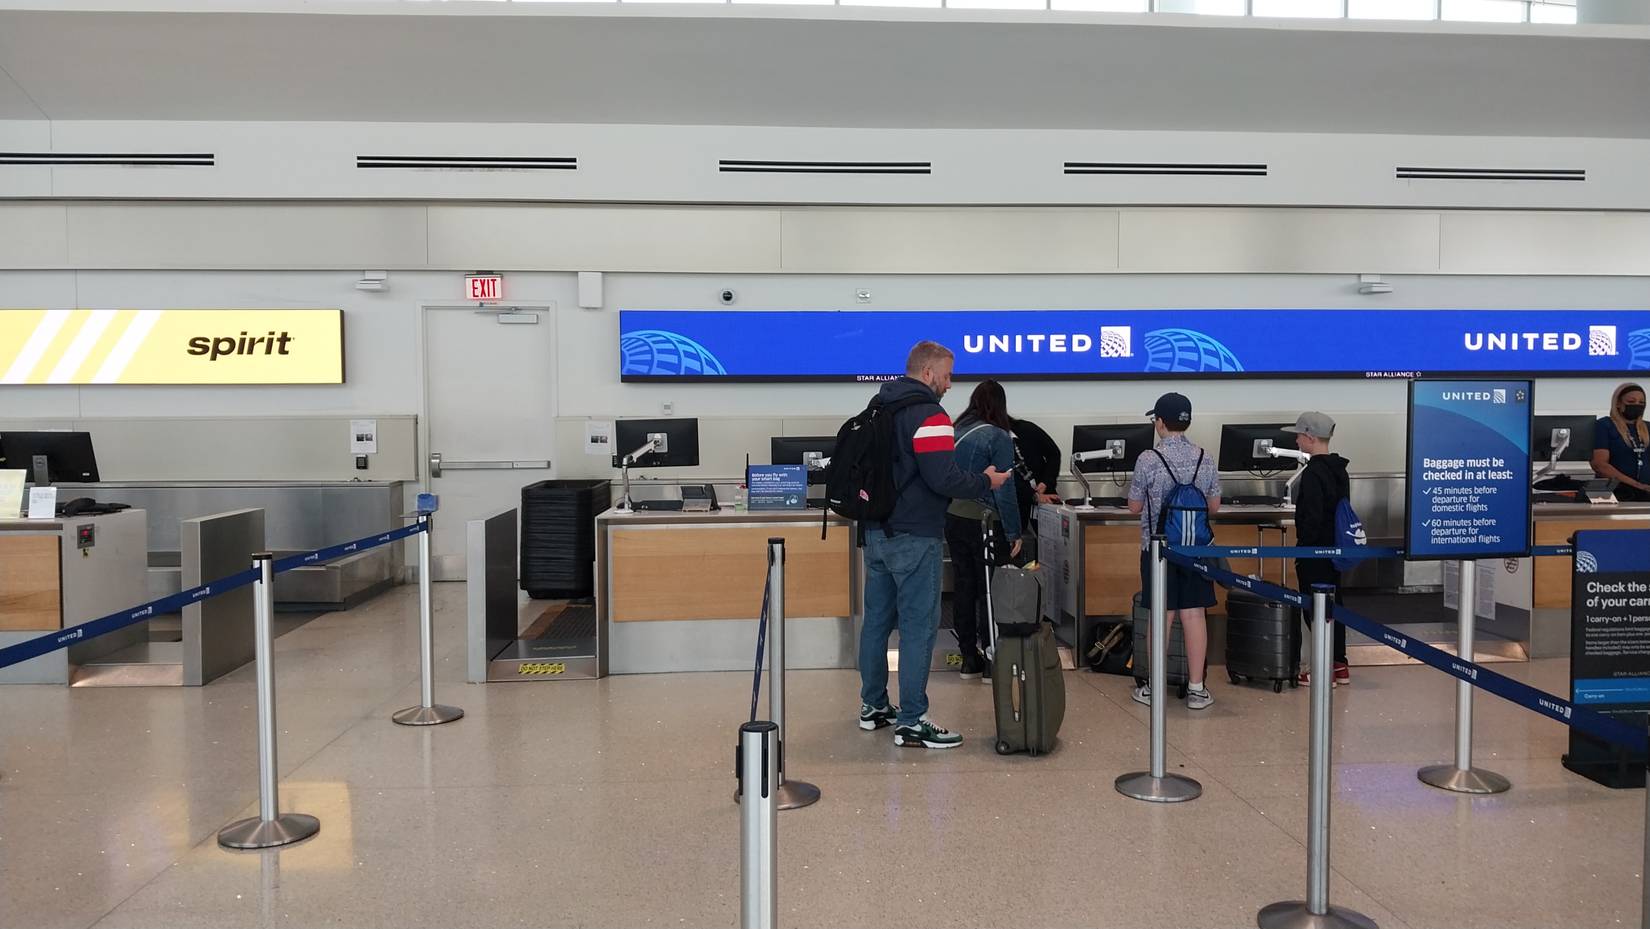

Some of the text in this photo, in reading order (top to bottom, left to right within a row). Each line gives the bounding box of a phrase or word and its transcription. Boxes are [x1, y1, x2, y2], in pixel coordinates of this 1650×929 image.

[472, 278, 497, 298] EXIT
[187, 331, 292, 361] spirit
[963, 334, 1092, 353] UNITED
[1464, 332, 1582, 351] UNITED
[1442, 391, 1490, 401] UNITED
[1423, 457, 1505, 470] Baggage must be
[1423, 469, 1514, 481] checked in at least:
[1432, 485, 1498, 495] 45 minutes before
[1432, 494, 1480, 505] departure for
[1431, 503, 1489, 513] domestic flights
[1431, 517, 1497, 527] 60 minutes before
[1431, 526, 1479, 537] departure for
[1430, 534, 1501, 545] international flights
[1586, 581, 1626, 593] Check
[1627, 581, 1647, 593] the
[1586, 596, 1599, 607] of
[1601, 597, 1628, 610] your
[131, 608, 148, 619] UNITED
[1590, 616, 1622, 624] carry-on
[57, 632, 78, 643] UNITED
[1383, 633, 1402, 646] UNITED
[1452, 662, 1473, 677] UNITED
[1539, 698, 1565, 714] UNITED
